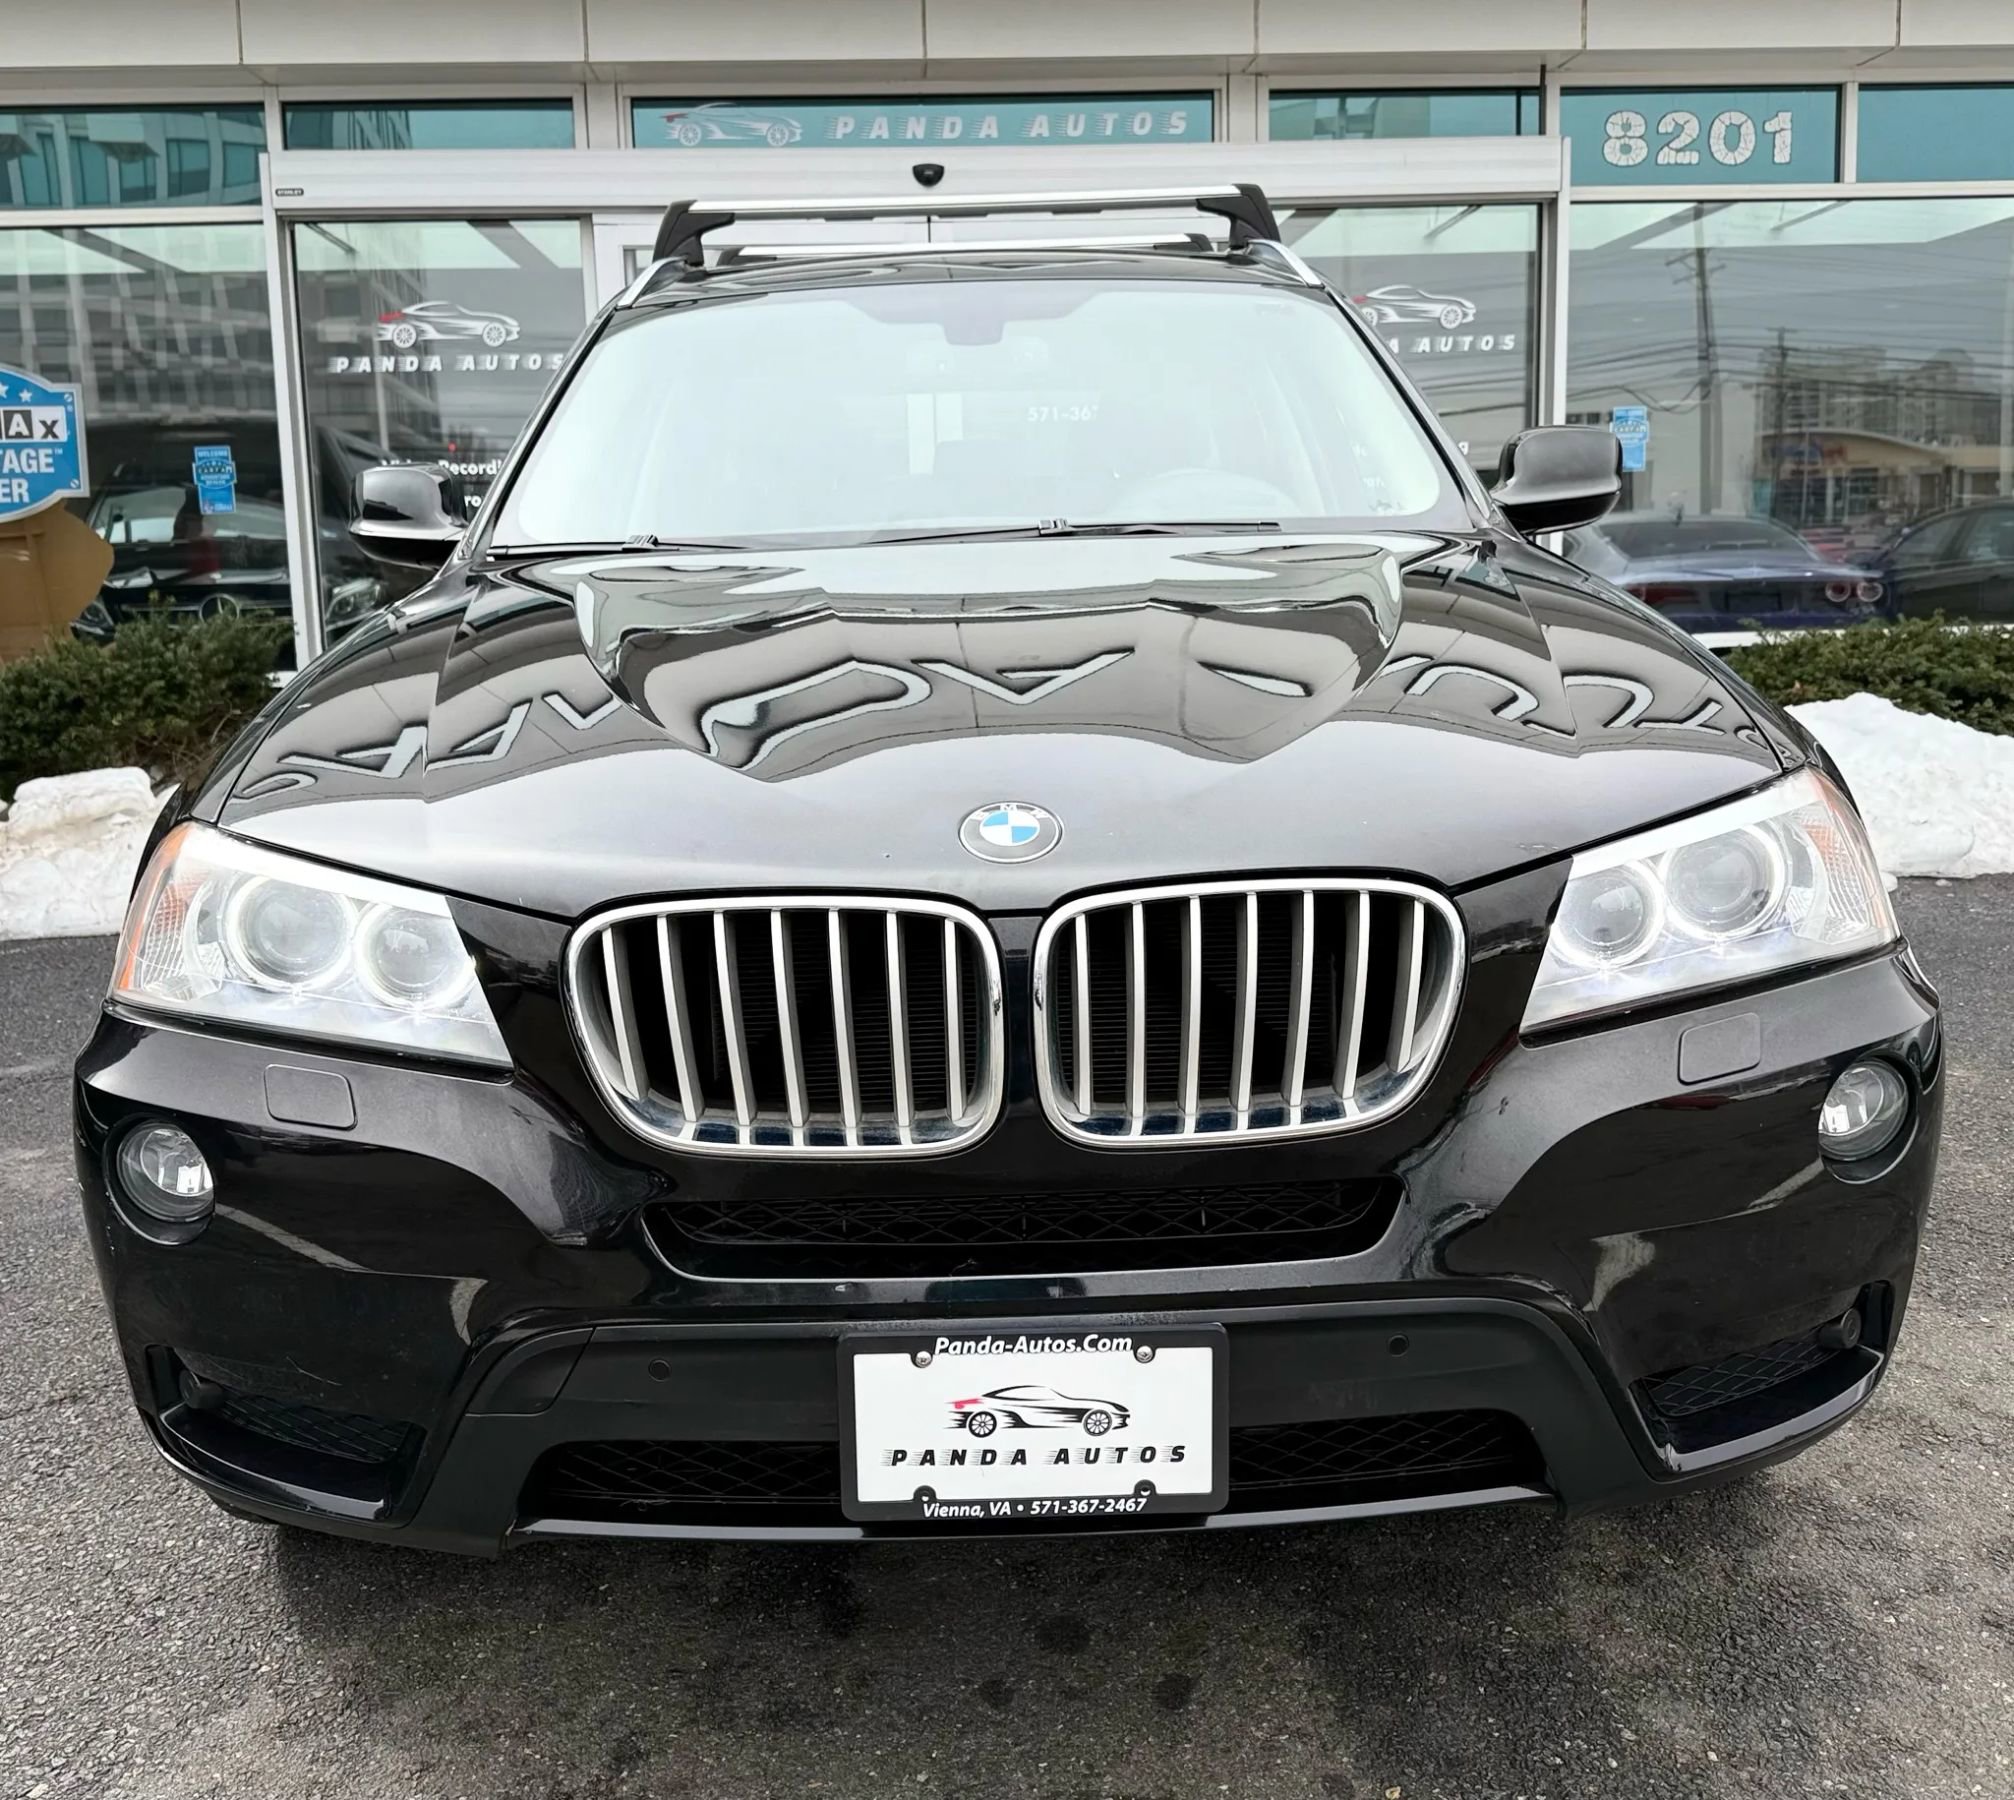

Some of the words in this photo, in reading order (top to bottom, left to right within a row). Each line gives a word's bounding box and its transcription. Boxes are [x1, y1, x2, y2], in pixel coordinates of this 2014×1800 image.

[832, 114, 999, 140] PANDA
[1027, 111, 1188, 138] AUTOS
[1602, 109, 1794, 167] 8201
[1416, 333, 1516, 354] AUTOS
[334, 355, 443, 374] PANDA
[460, 353, 564, 372] AUTOS
[933, 1333, 1133, 1357] Panda-Autos.Com
[889, 1447, 1027, 1467] PANDA
[1052, 1444, 1186, 1465] AUTOS
[922, 1501, 985, 1519] Vienna,
[988, 1501, 1012, 1516] VA
[1029, 1497, 1148, 1515] 571-367-2467
